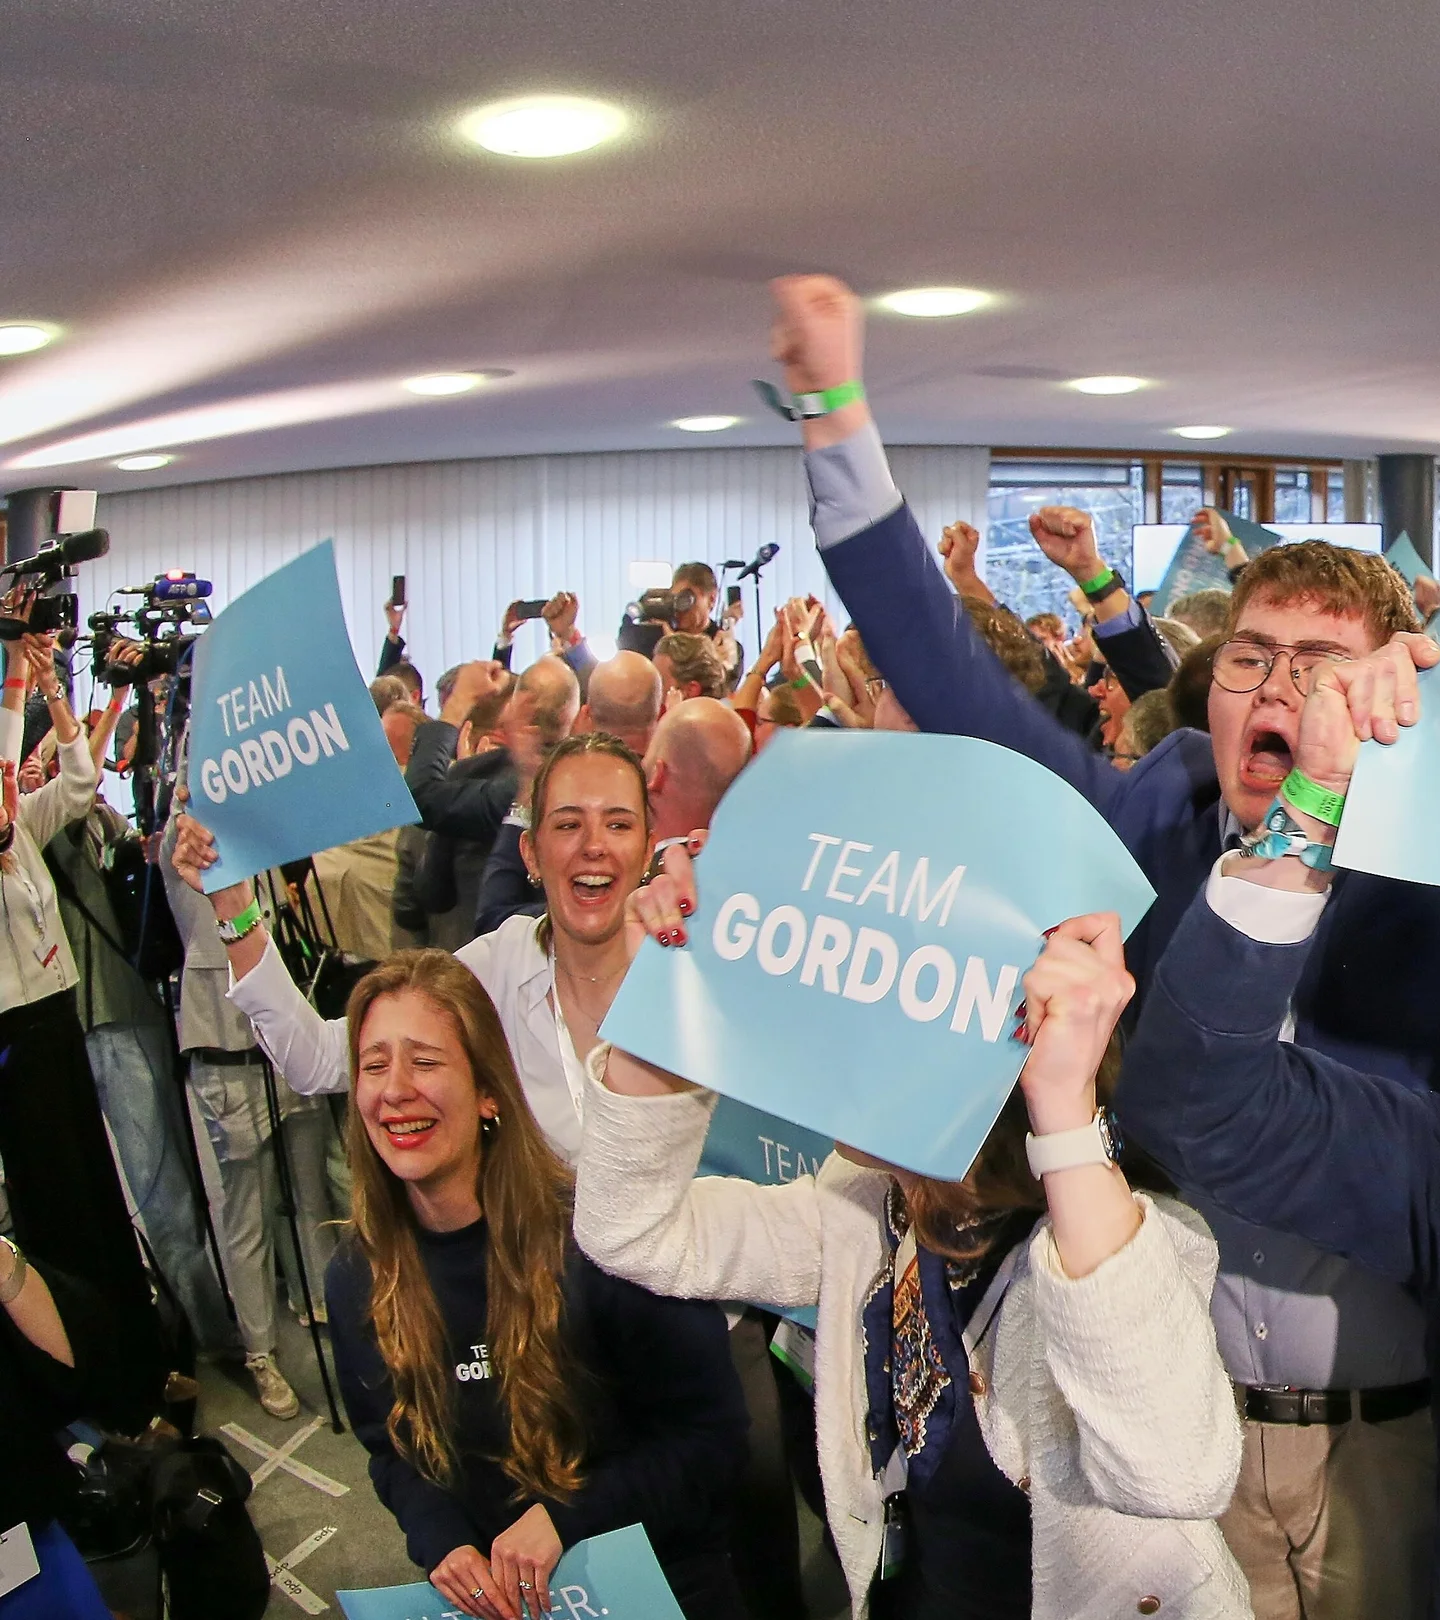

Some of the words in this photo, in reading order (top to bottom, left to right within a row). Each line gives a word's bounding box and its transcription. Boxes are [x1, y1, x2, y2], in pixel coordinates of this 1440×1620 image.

[216, 665, 292, 737] TEAM
[201, 702, 350, 805] GORDON
[800, 832, 966, 927] TEAM
[713, 892, 1020, 1044] GORDON
[455, 1360, 492, 1381] GOR
[470, 1344, 488, 1359] TE
